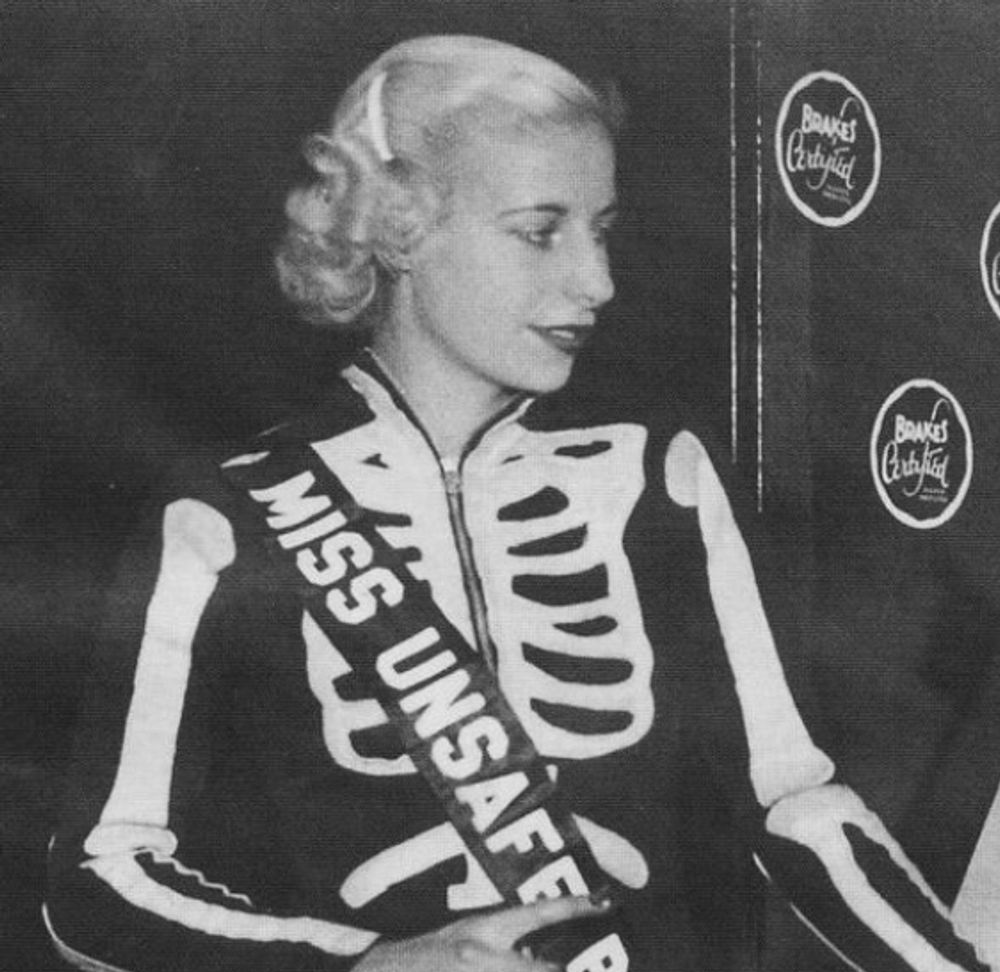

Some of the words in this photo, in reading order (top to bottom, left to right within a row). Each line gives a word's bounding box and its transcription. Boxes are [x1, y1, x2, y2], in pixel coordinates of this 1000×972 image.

[801, 97, 861, 144] BRAKES
[787, 128, 857, 189] Certified
[895, 398, 950, 443] BRAKES
[882, 440, 949, 496] Certified
[248, 470, 404, 625] MISS
[375, 625, 591, 905] UNSAFE
